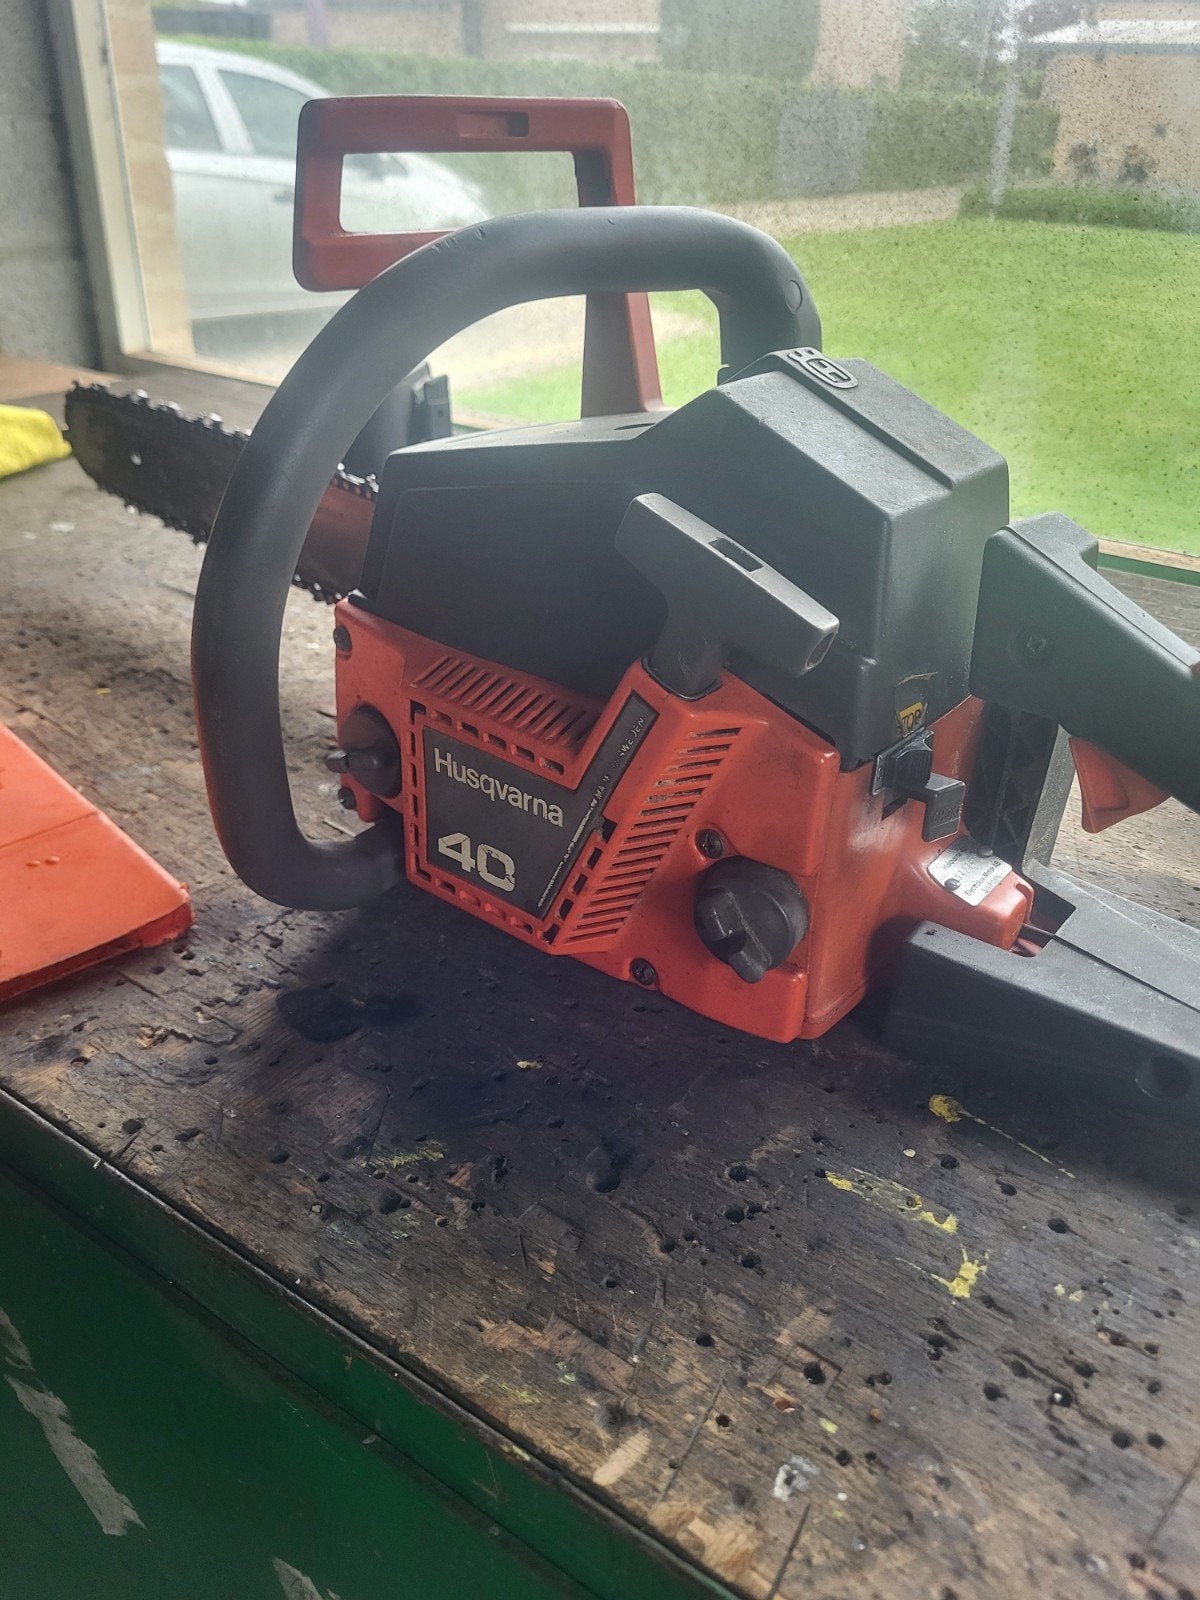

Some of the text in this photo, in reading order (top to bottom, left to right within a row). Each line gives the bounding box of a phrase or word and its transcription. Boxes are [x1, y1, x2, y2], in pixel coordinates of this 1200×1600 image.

[897, 709, 922, 730] TOP
[434, 747, 563, 827] Husqvarna
[438, 832, 515, 892] 40
